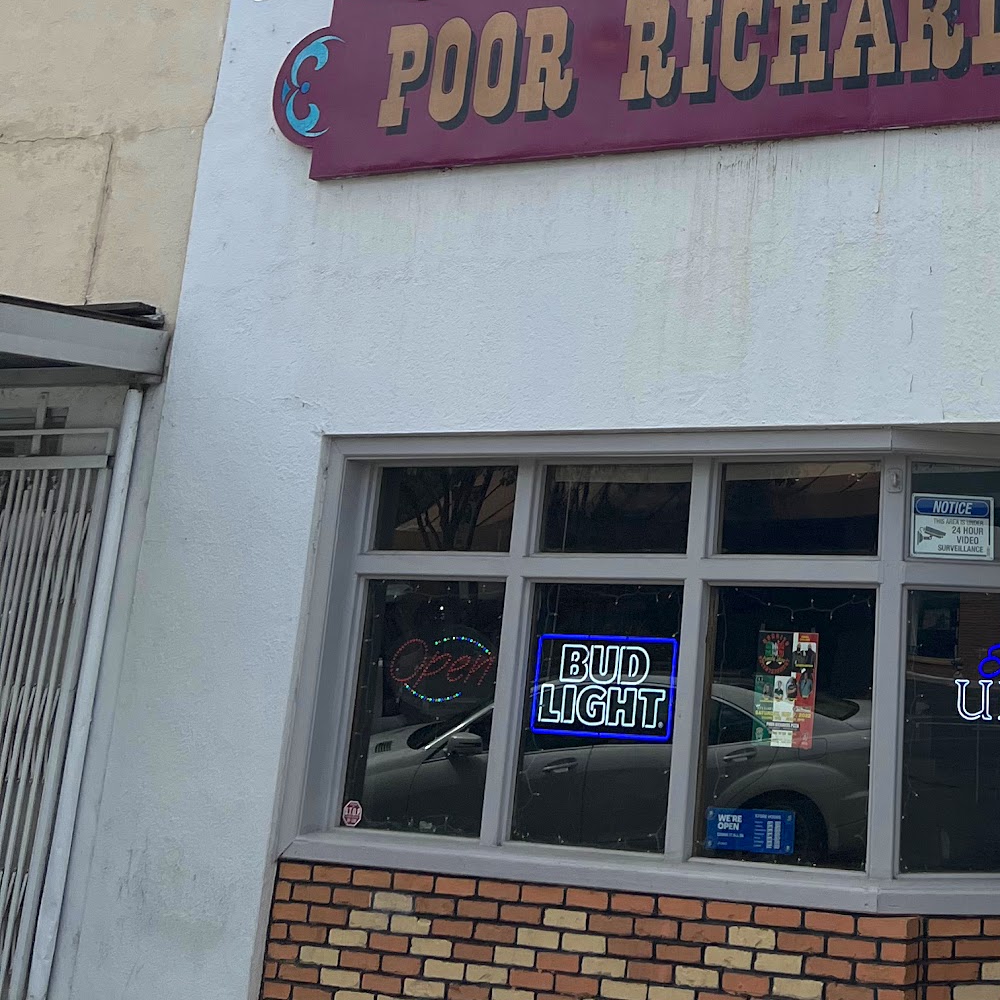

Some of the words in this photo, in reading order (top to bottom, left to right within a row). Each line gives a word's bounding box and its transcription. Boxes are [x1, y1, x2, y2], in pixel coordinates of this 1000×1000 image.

[377, 6, 574, 130] POOR
[932, 500, 973, 515] NOTICE
[933, 517, 945, 525] THIS
[945, 518, 960, 526] AREA
[951, 525, 962, 535] 24
[963, 526, 984, 536] HOUR
[956, 535, 979, 546] VIDEO
[937, 544, 984, 554] SURVEILLANCE
[389, 638, 495, 689] Open
[559, 643, 651, 686] BUD
[537, 684, 666, 729] LIGHT
[717, 813, 743, 823] WE'RE
[717, 822, 740, 831] OPEN
